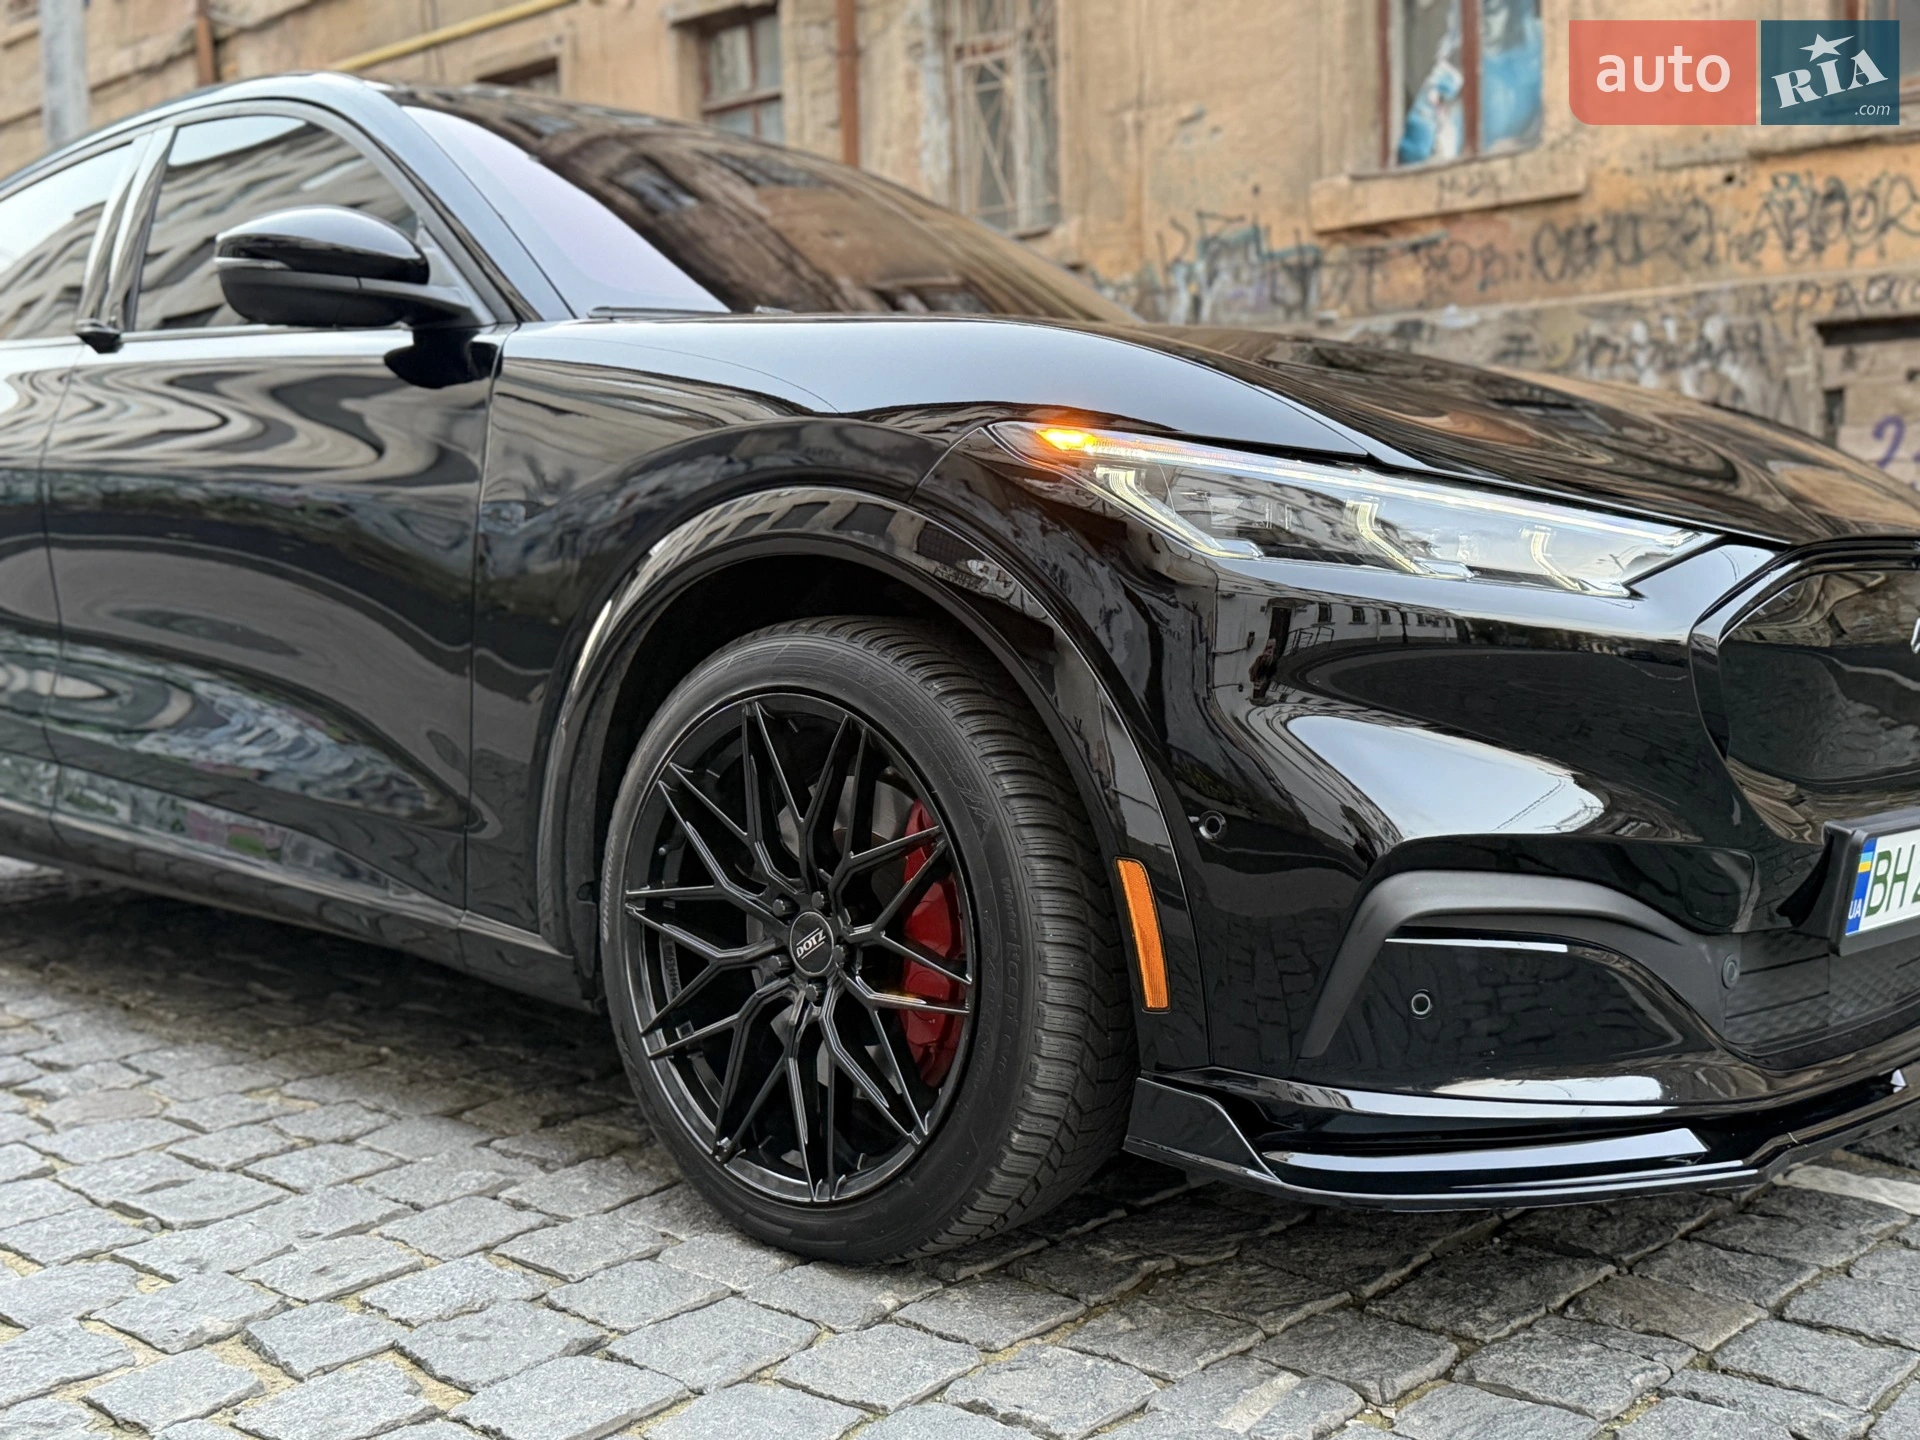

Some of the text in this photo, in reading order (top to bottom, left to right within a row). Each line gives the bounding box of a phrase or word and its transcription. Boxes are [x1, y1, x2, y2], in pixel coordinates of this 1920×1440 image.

[1865, 844, 1916, 918] BH
[1848, 898, 1863, 920] UA
[795, 929, 826, 958] DOTZ
